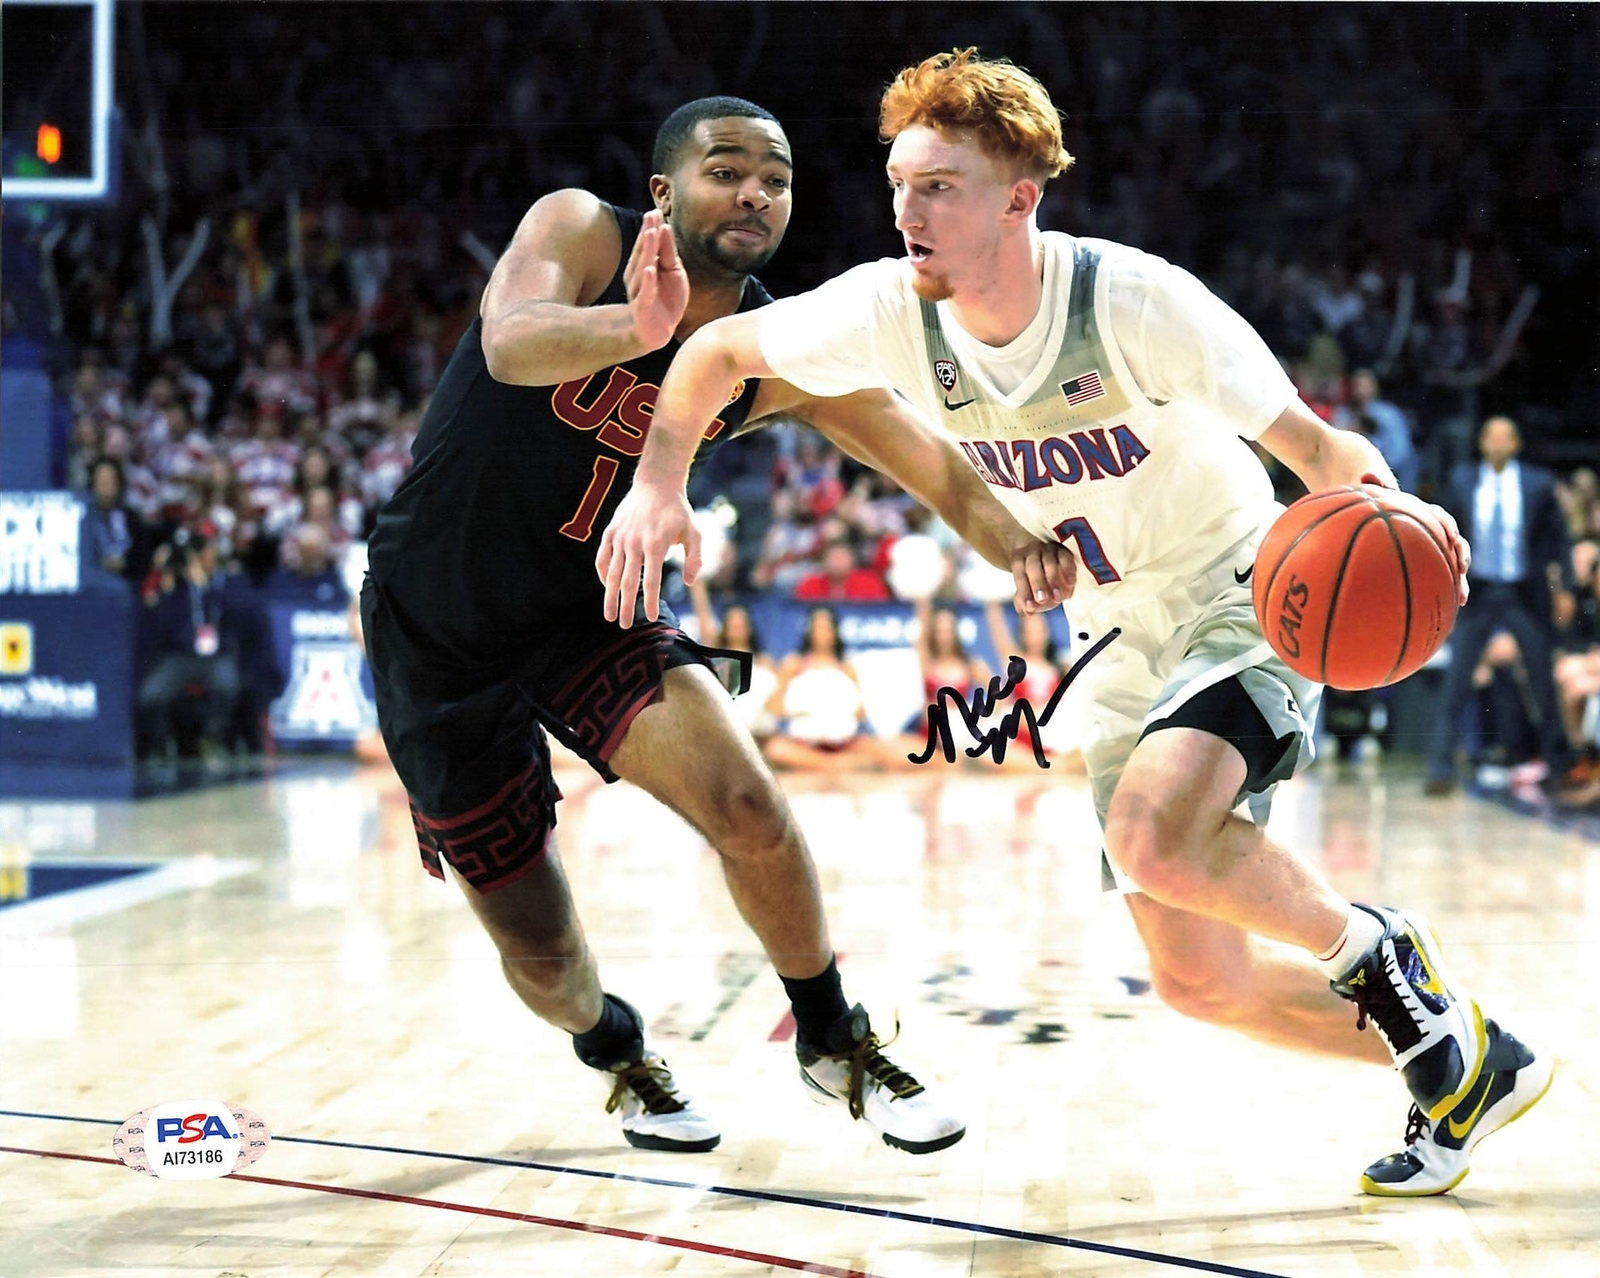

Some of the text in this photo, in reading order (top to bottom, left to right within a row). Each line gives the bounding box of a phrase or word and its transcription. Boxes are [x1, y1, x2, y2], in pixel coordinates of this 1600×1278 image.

[551, 366, 726, 456] US
[558, 455, 620, 542] 1
[1278, 573, 1309, 659] CATS
